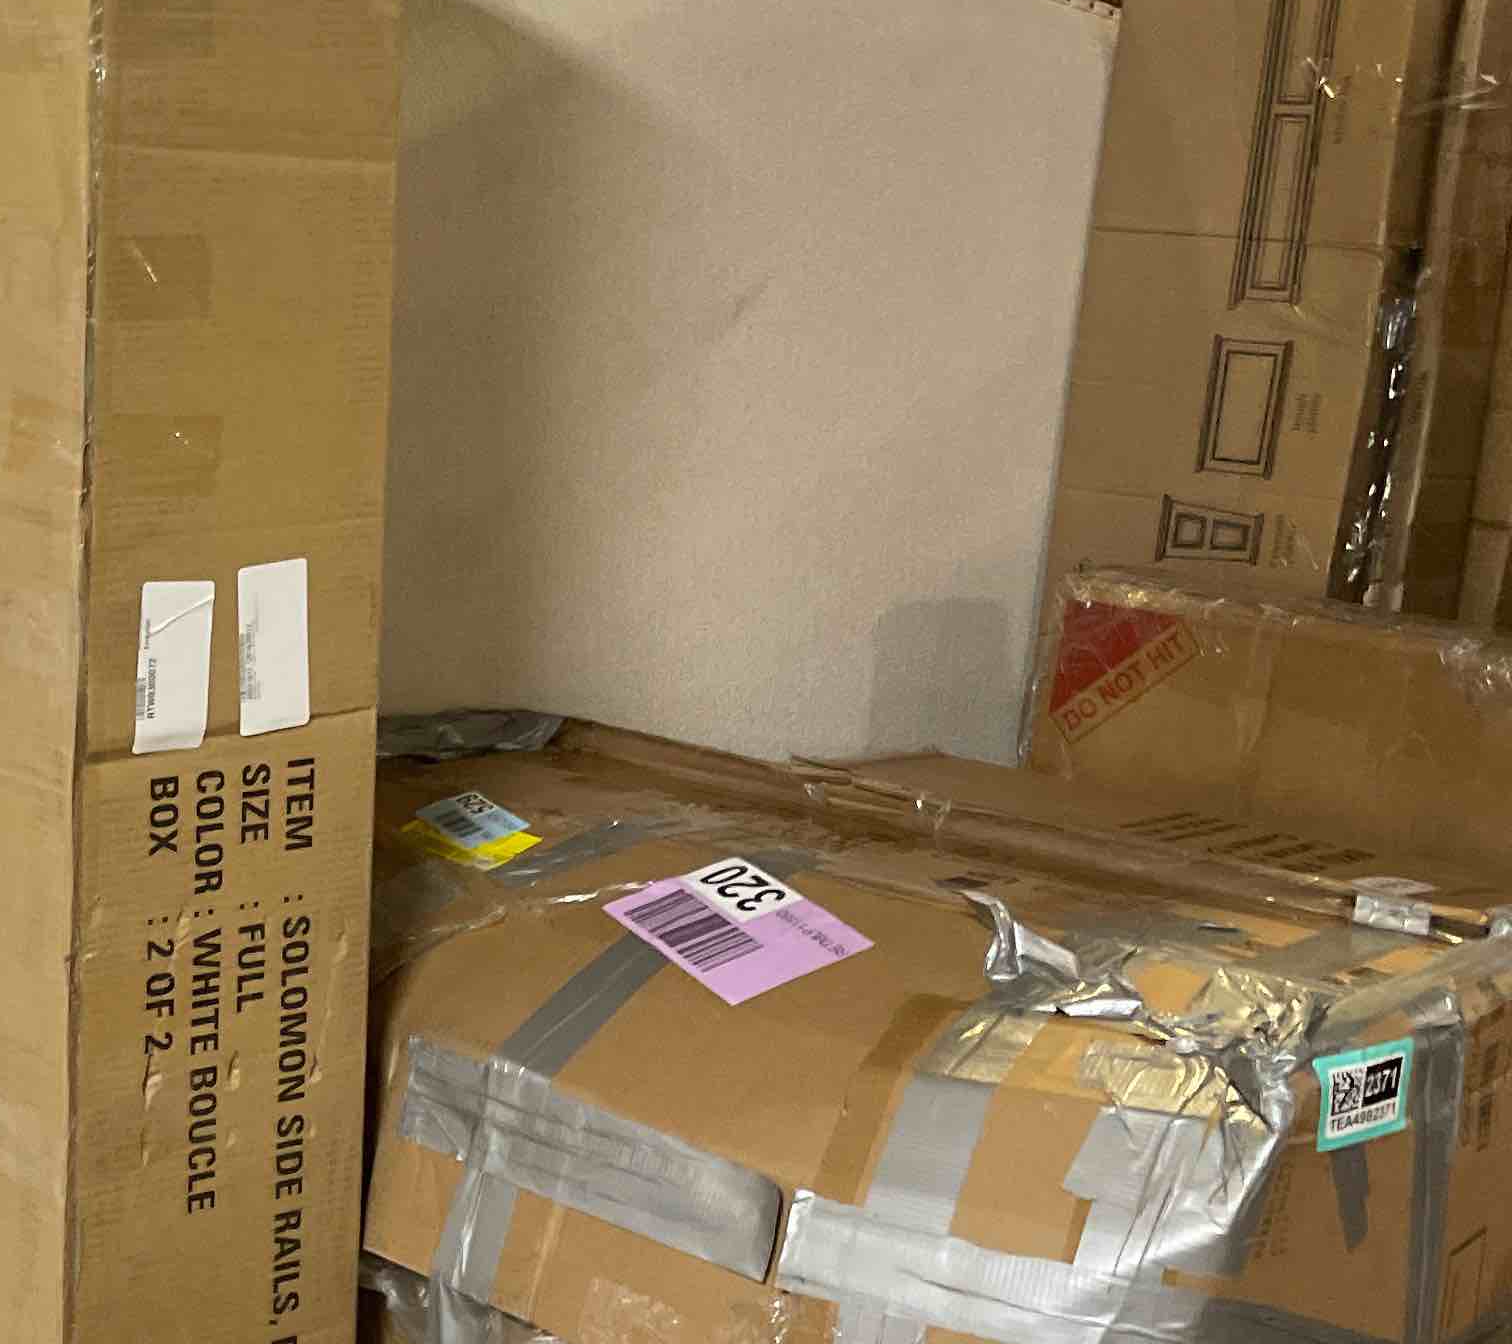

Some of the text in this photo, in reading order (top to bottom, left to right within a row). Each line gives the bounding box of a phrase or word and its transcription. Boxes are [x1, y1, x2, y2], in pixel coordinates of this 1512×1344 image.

[1063, 698, 1097, 731] DO
[1098, 661, 1146, 704] NOT
[149, 776, 179, 857] BOX
[194, 770, 224, 896] COLOR
[240, 764, 270, 845] SIZE
[285, 758, 315, 851] ITEM
[699, 865, 788, 913] 320
[148, 939, 175, 960] 2
[236, 923, 265, 1014] FULL
[147, 973, 175, 1018] OF
[190, 929, 222, 1055] WHITE
[277, 916, 311, 1103] SOLOMON
[145, 1032, 173, 1057] 2
[1365, 1067, 1398, 1097] 2371
[188, 1066, 218, 1214] BOUCLE
[275, 1114, 304, 1199] SIDE
[271, 1208, 302, 1326] RAILS,
